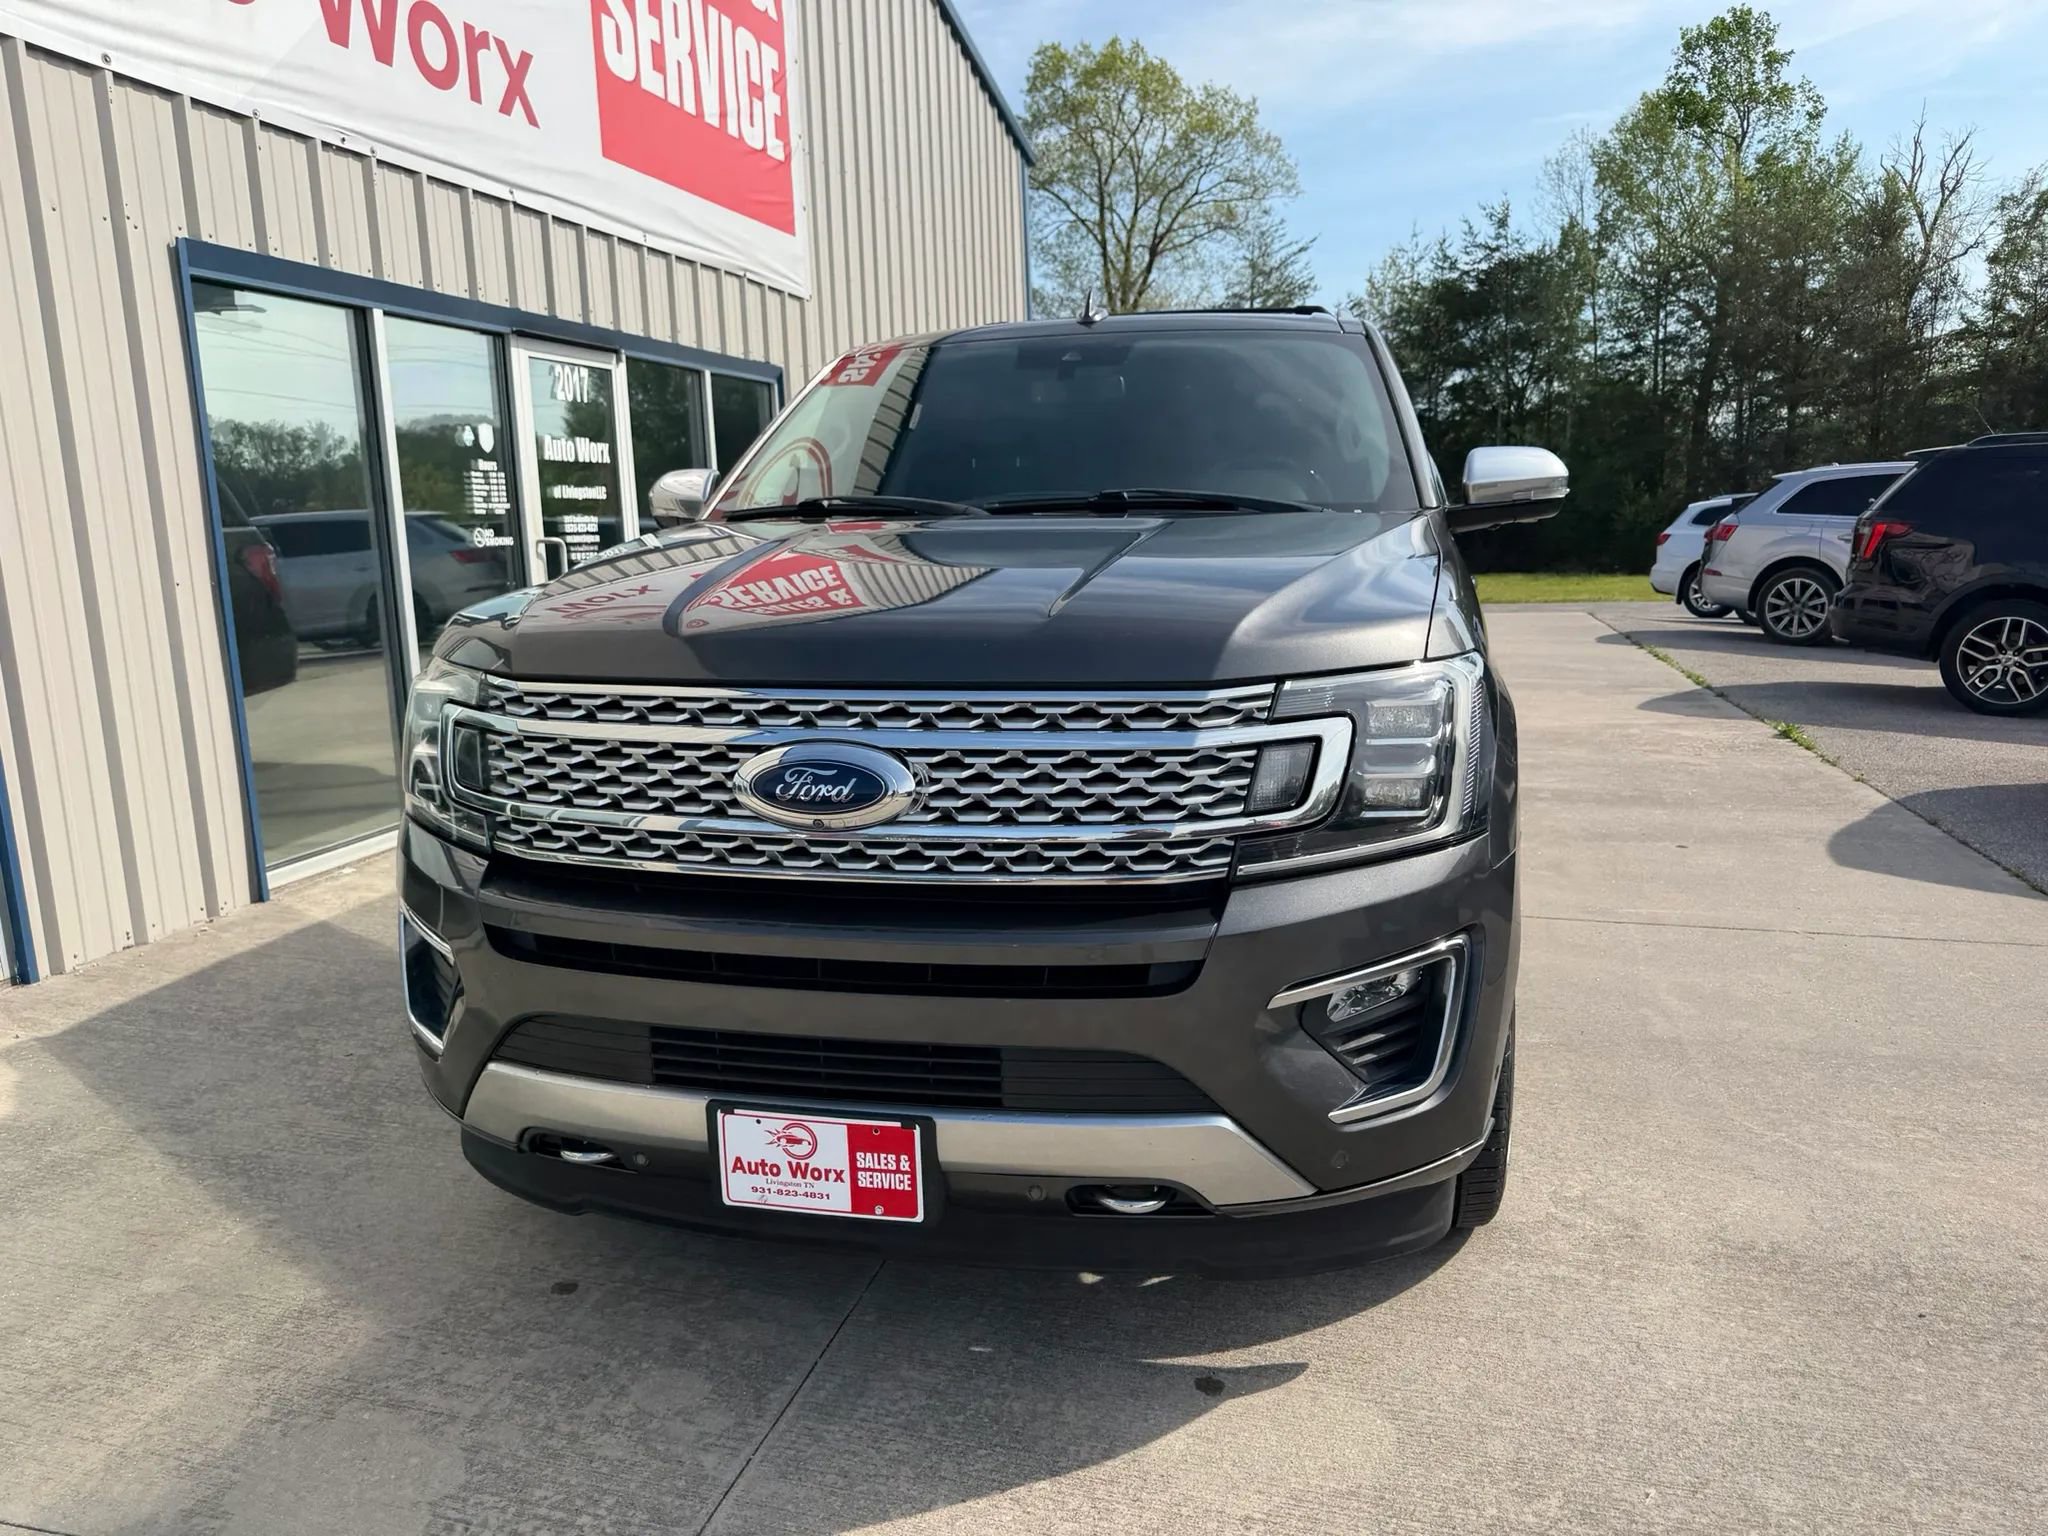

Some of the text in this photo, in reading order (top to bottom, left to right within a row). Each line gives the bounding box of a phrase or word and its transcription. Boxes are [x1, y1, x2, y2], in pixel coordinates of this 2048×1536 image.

[318, 0, 541, 130] Worx
[600, 0, 785, 163] SERVICE
[555, 364, 589, 403] 2017
[544, 434, 611, 464] Auto Worx
[485, 536, 515, 546] SMOKING
[775, 766, 857, 803] Ford
[731, 1156, 846, 1184] Auto Worx
[856, 1151, 911, 1172] SALES &
[751, 1186, 831, 1201] 931-823-4831
[765, 1178, 815, 1189] Livingston TN
[857, 1172, 912, 1191] SERVICE
